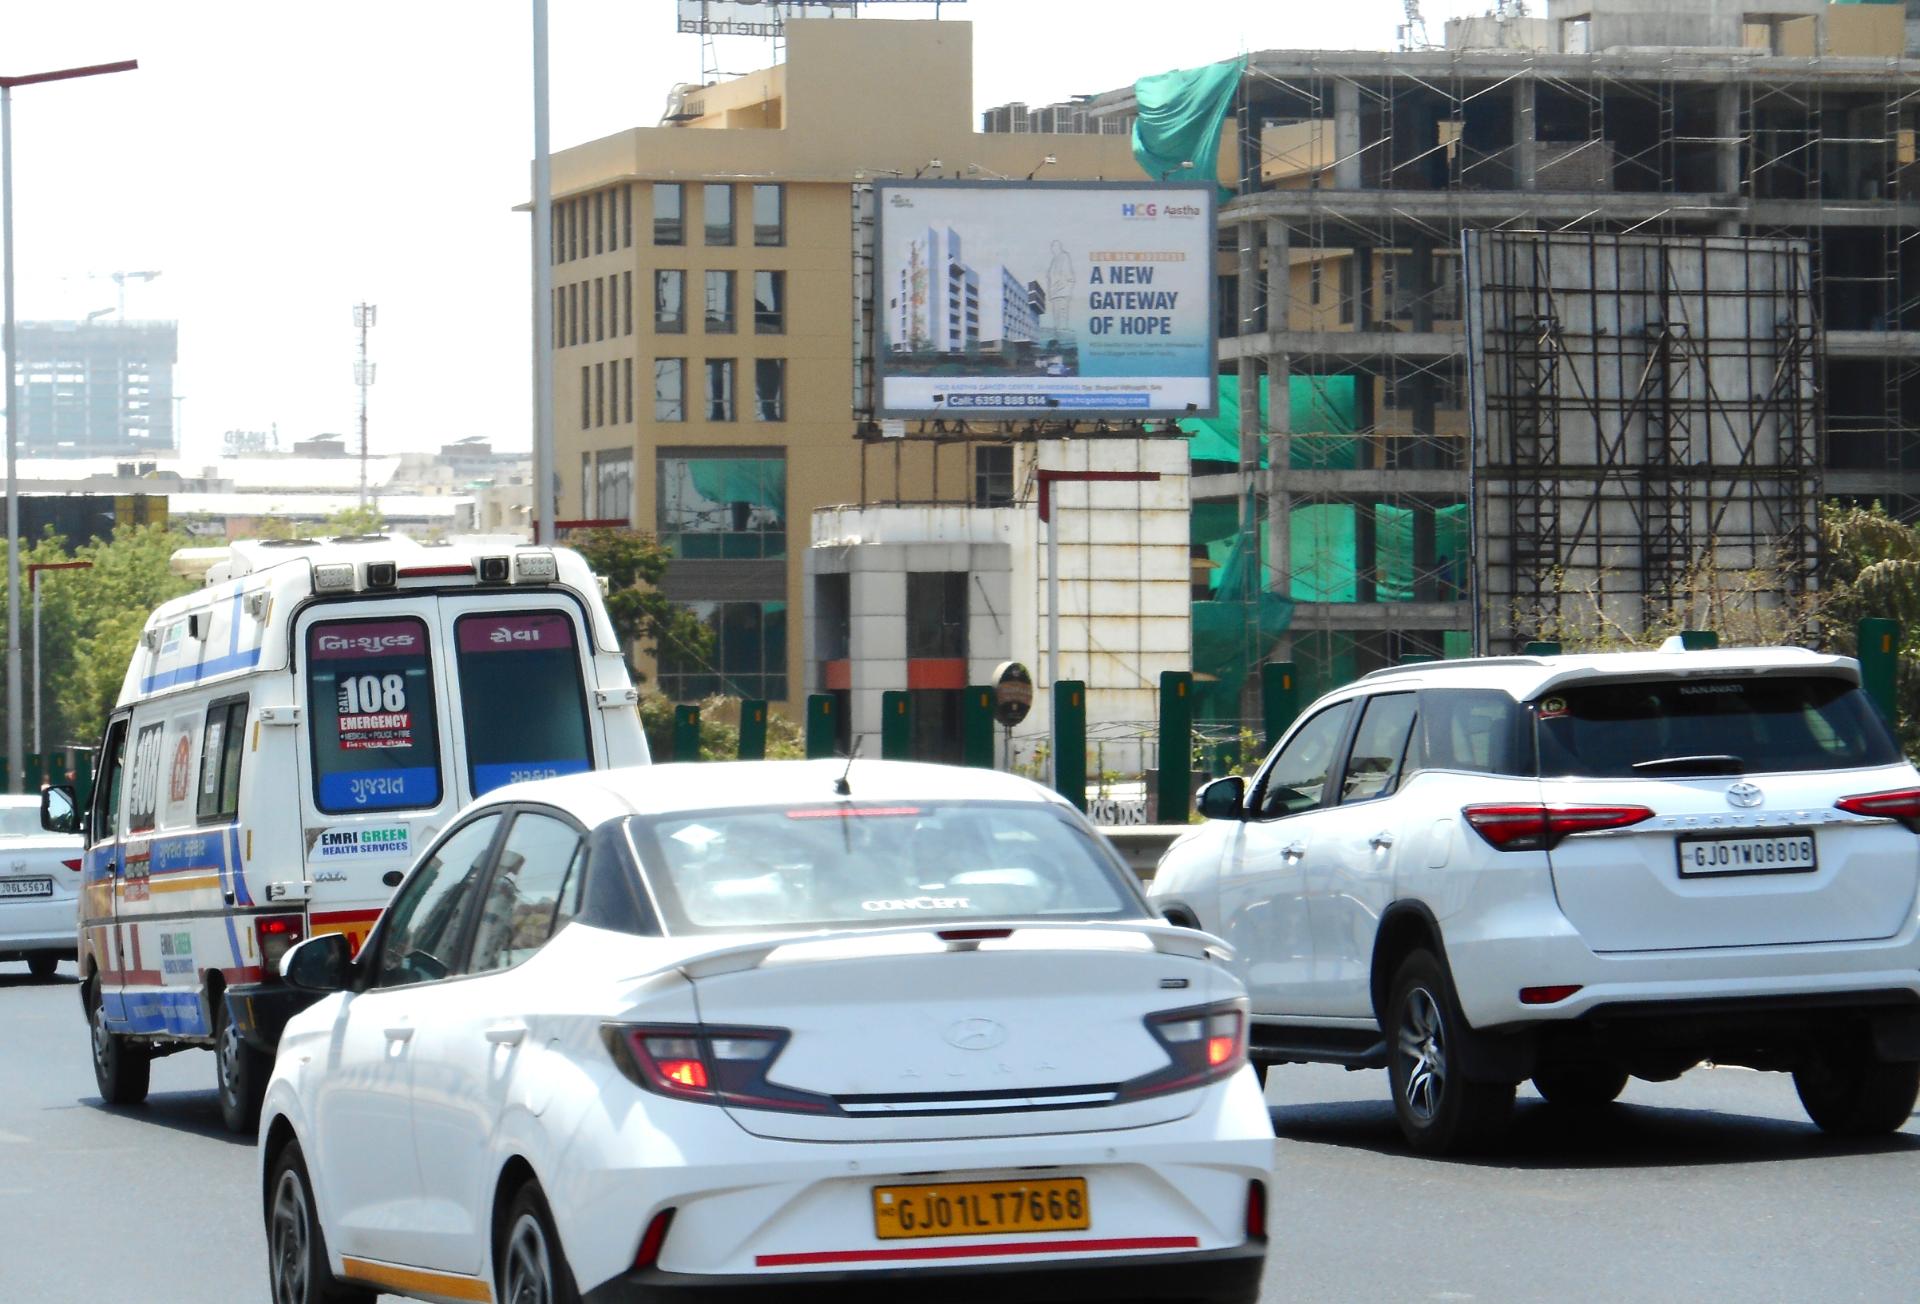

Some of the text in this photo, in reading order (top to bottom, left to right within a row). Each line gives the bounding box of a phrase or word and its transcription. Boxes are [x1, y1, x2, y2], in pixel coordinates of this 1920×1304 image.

[1122, 203, 1200, 217] HCG Aastha
[1090, 266, 1154, 285] A NEW
[1089, 291, 1179, 310] GATEWAY
[1089, 316, 1172, 335] OF HOPE
[490, 627, 540, 643] સેવા
[337, 690, 349, 714] CALL
[340, 673, 406, 714] 108
[340, 714, 408, 731] EMERGENCY
[350, 776, 405, 803] ગુજરાત
[321, 828, 408, 846] EMRI GREEN
[322, 841, 408, 856] HEALTH SERVICES
[899, 1188, 1082, 1231] GJ01LT7668
